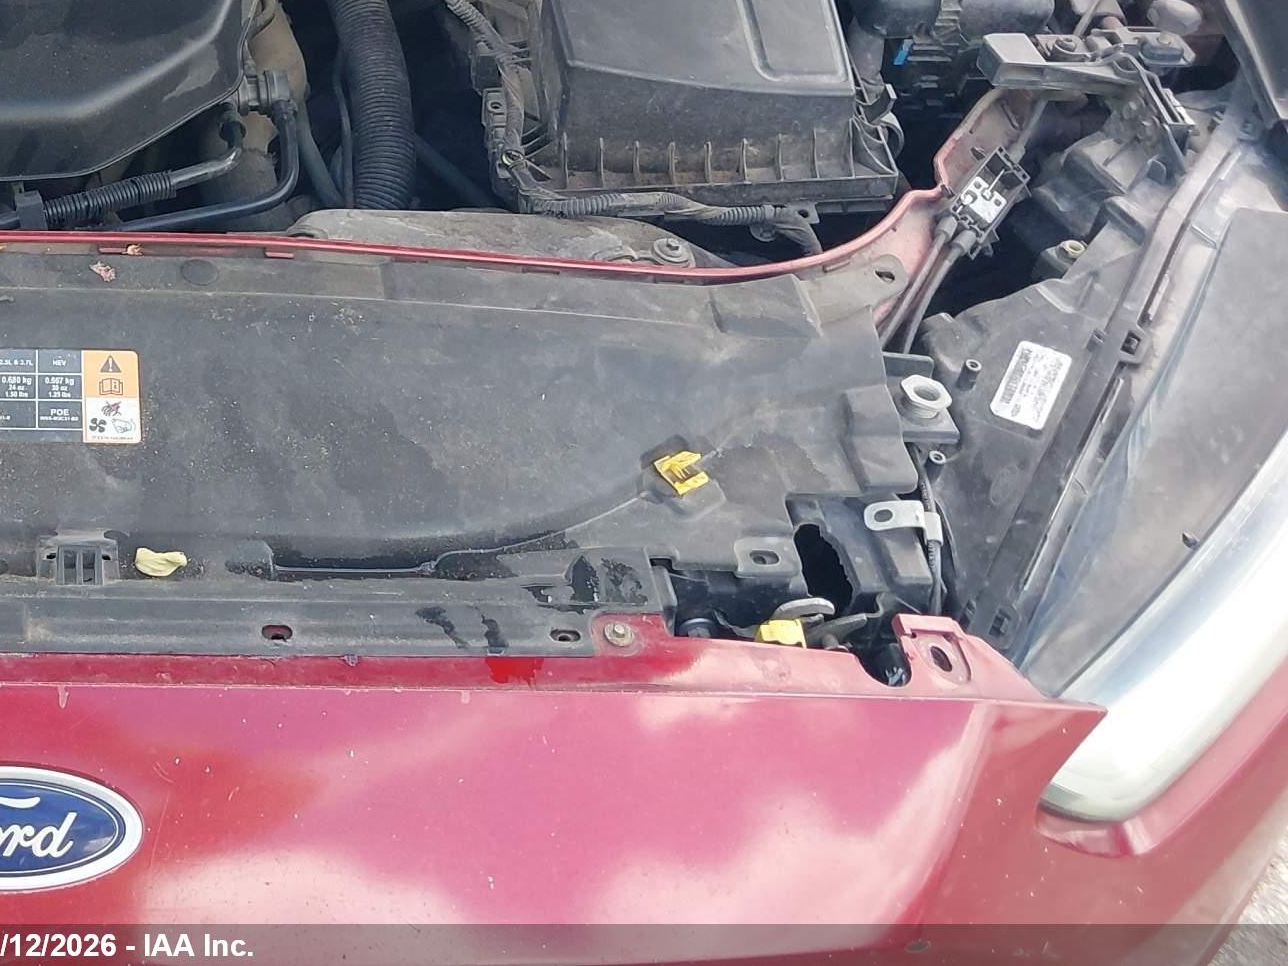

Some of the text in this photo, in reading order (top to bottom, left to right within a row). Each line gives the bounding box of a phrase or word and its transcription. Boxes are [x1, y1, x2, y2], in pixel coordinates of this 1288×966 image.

[1, 376, 33, 386] 0.680 kg
[44, 376, 75, 386] 0.567 kg
[50, 408, 70, 416] POE
